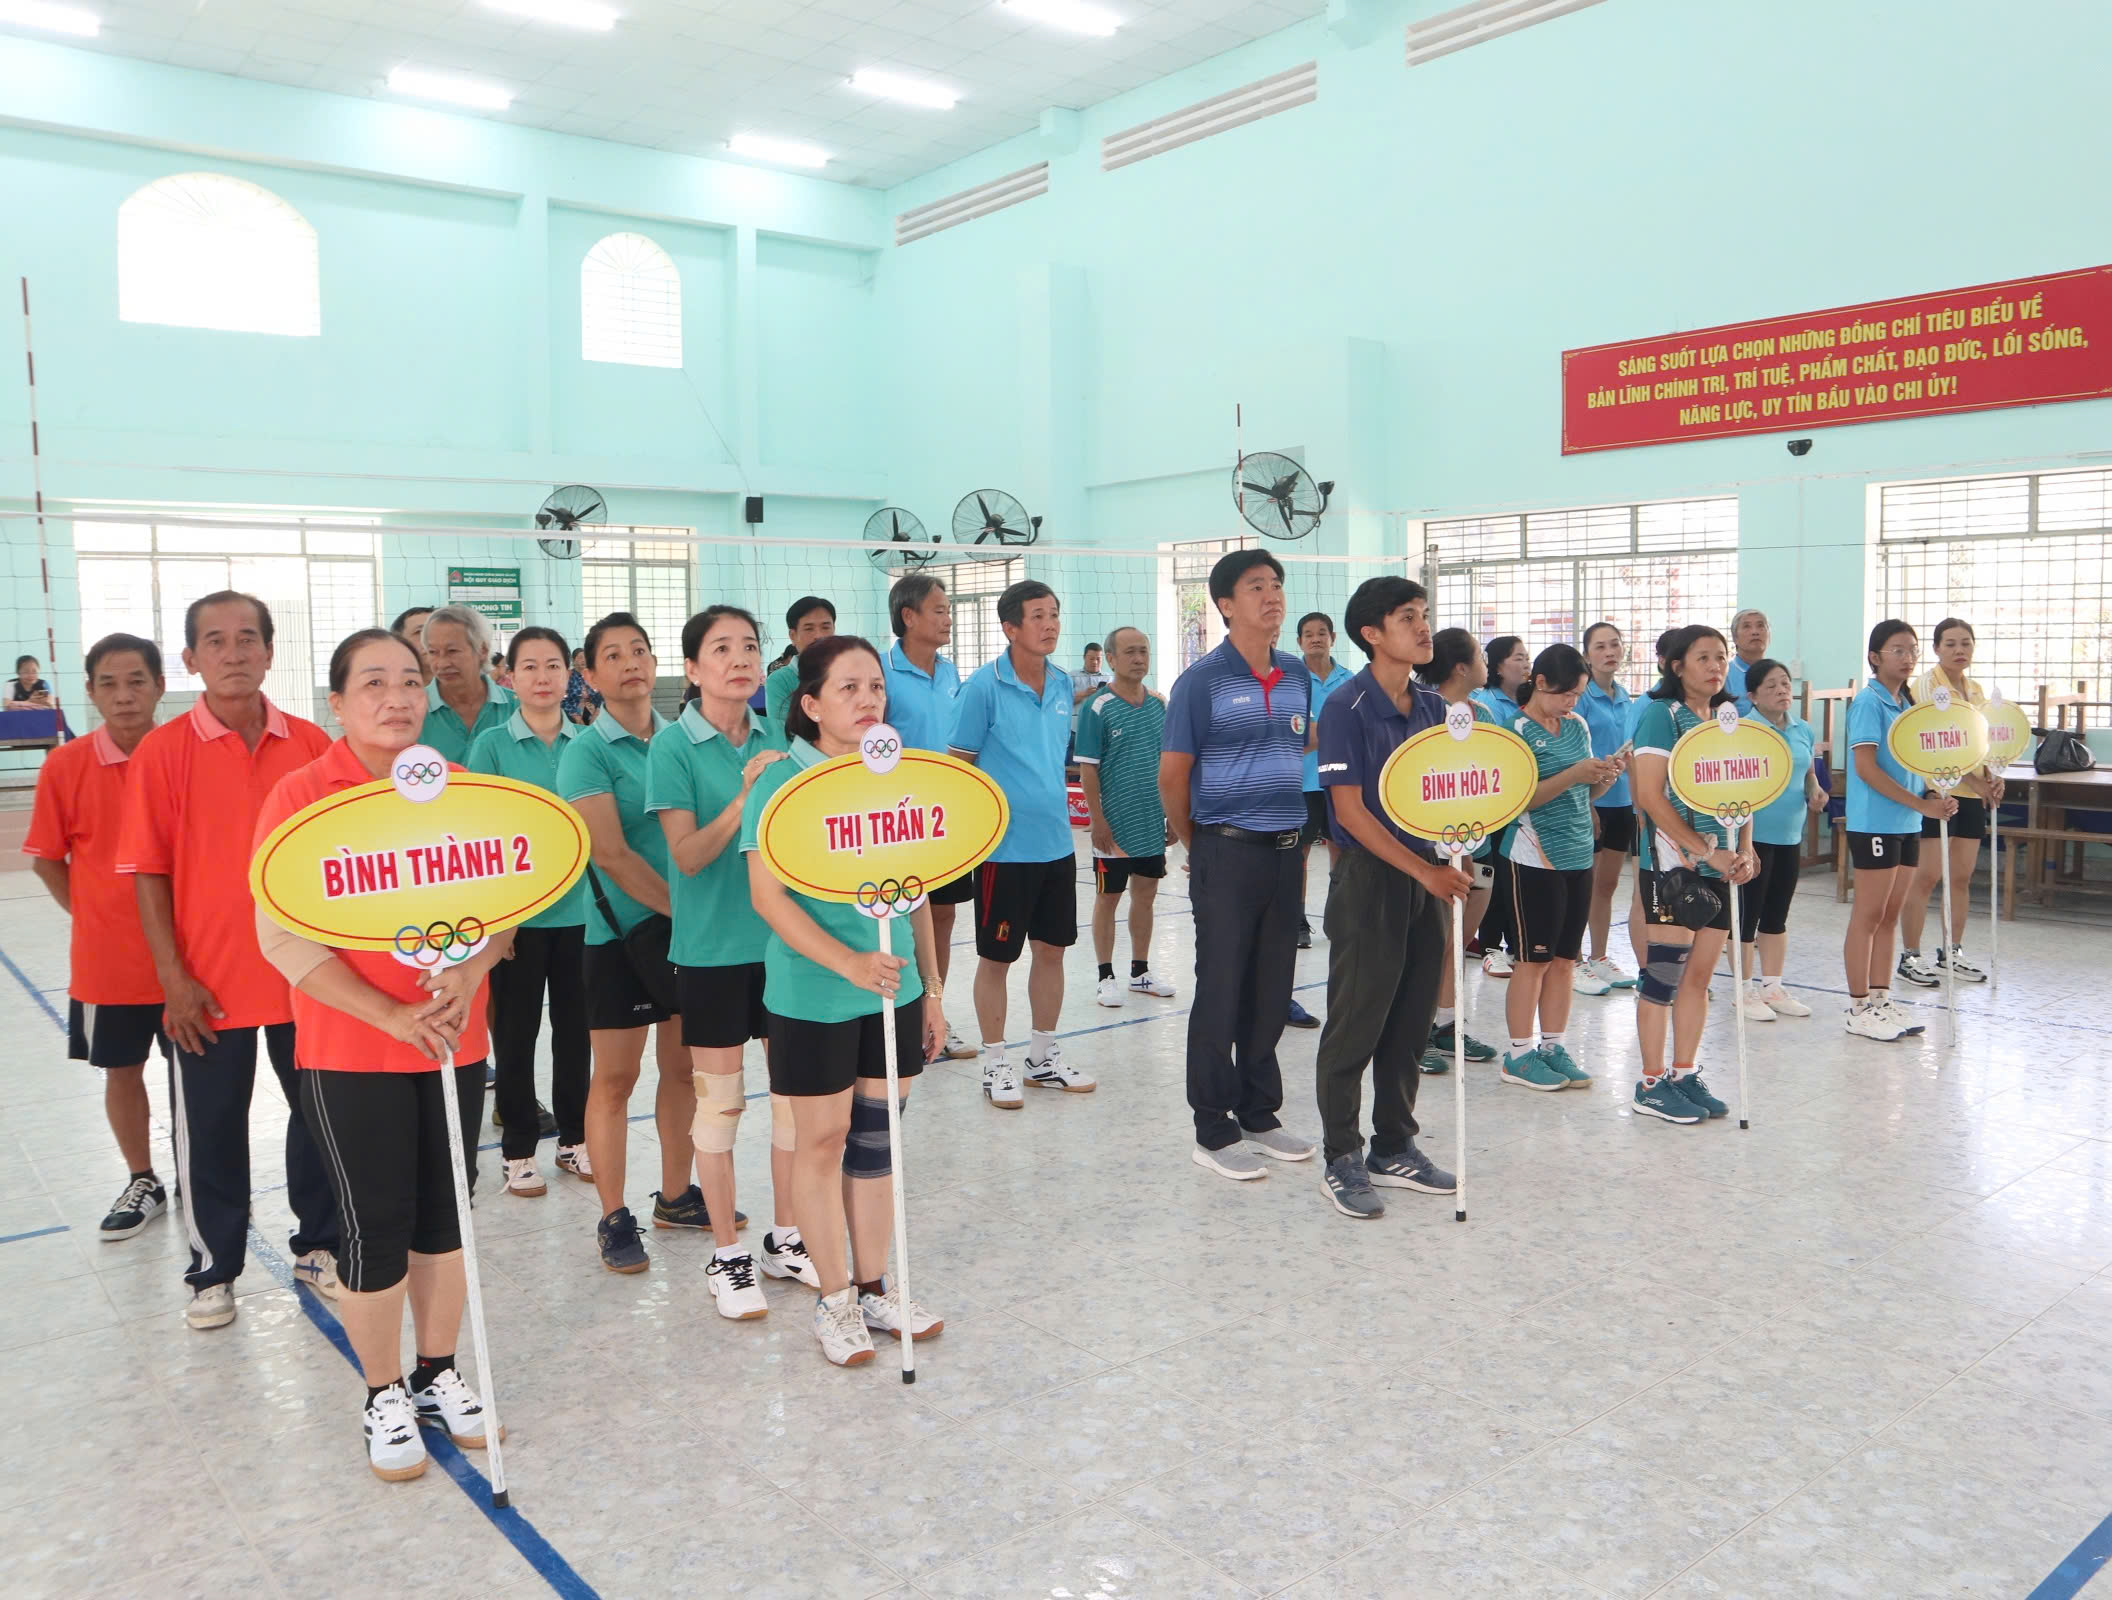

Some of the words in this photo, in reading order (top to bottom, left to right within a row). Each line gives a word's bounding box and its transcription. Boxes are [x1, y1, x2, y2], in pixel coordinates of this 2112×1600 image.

[1618, 355, 1656, 376] SÁNG
[1660, 345, 1696, 371] SUỐT
[1700, 344, 1728, 366] LỰA
[1732, 339, 1775, 363] CHỌN
[1779, 329, 1835, 354] NHỮNG
[1840, 319, 1887, 346] ĐỒNG
[1891, 314, 1921, 337] CHÍ
[1926, 307, 1966, 332] TIÊU
[1970, 296, 2014, 327] BIỂU
[2019, 291, 2043, 321] VỀ
[1587, 386, 1616, 409] BẢN
[1619, 383, 1651, 405] LĨNH
[1654, 378, 1698, 400] CHÍNH
[1702, 374, 1729, 394] TRỊ,
[1733, 368, 1758, 390] TRÍ
[1761, 362, 1794, 387] TUỆ,
[1799, 353, 1848, 382] PHẨM
[1852, 350, 1899, 376] CHẤT,
[1903, 346, 1939, 369] ĐẠO
[1944, 339, 1987, 363] ĐỨC,
[1992, 329, 2023, 357] LỐI
[2028, 323, 2089, 351] SỐNG,
[1679, 404, 1721, 426] NĂNG
[1725, 398, 1758, 421] LỰC,
[1762, 398, 1781, 416] UY
[1787, 391, 1813, 413] TÍN
[1817, 382, 1849, 410] BẦU
[1855, 382, 1888, 406] VÀO
[1893, 379, 1922, 400] CHI
[1927, 372, 1957, 398] ỦY!
[1919, 732, 1936, 753] THỊ
[1937, 725, 1961, 748] TRẤN
[1963, 730, 1969, 746] 1
[1422, 768, 1456, 801] BÌNH
[1460, 764, 1488, 796] HÒA
[1492, 768, 1500, 793] 2
[1694, 756, 1721, 784] BÌNH
[1723, 753, 1760, 780] THÀNH
[1763, 757, 1769, 778] 1
[825, 814, 862, 855] THỊ
[868, 796, 924, 845] TRẤN
[931, 805, 945, 838] 2
[1871, 836, 1884, 857] 6
[323, 848, 399, 897] BÌNH
[406, 835, 504, 885] THÀNH
[513, 836, 531, 872] 2
